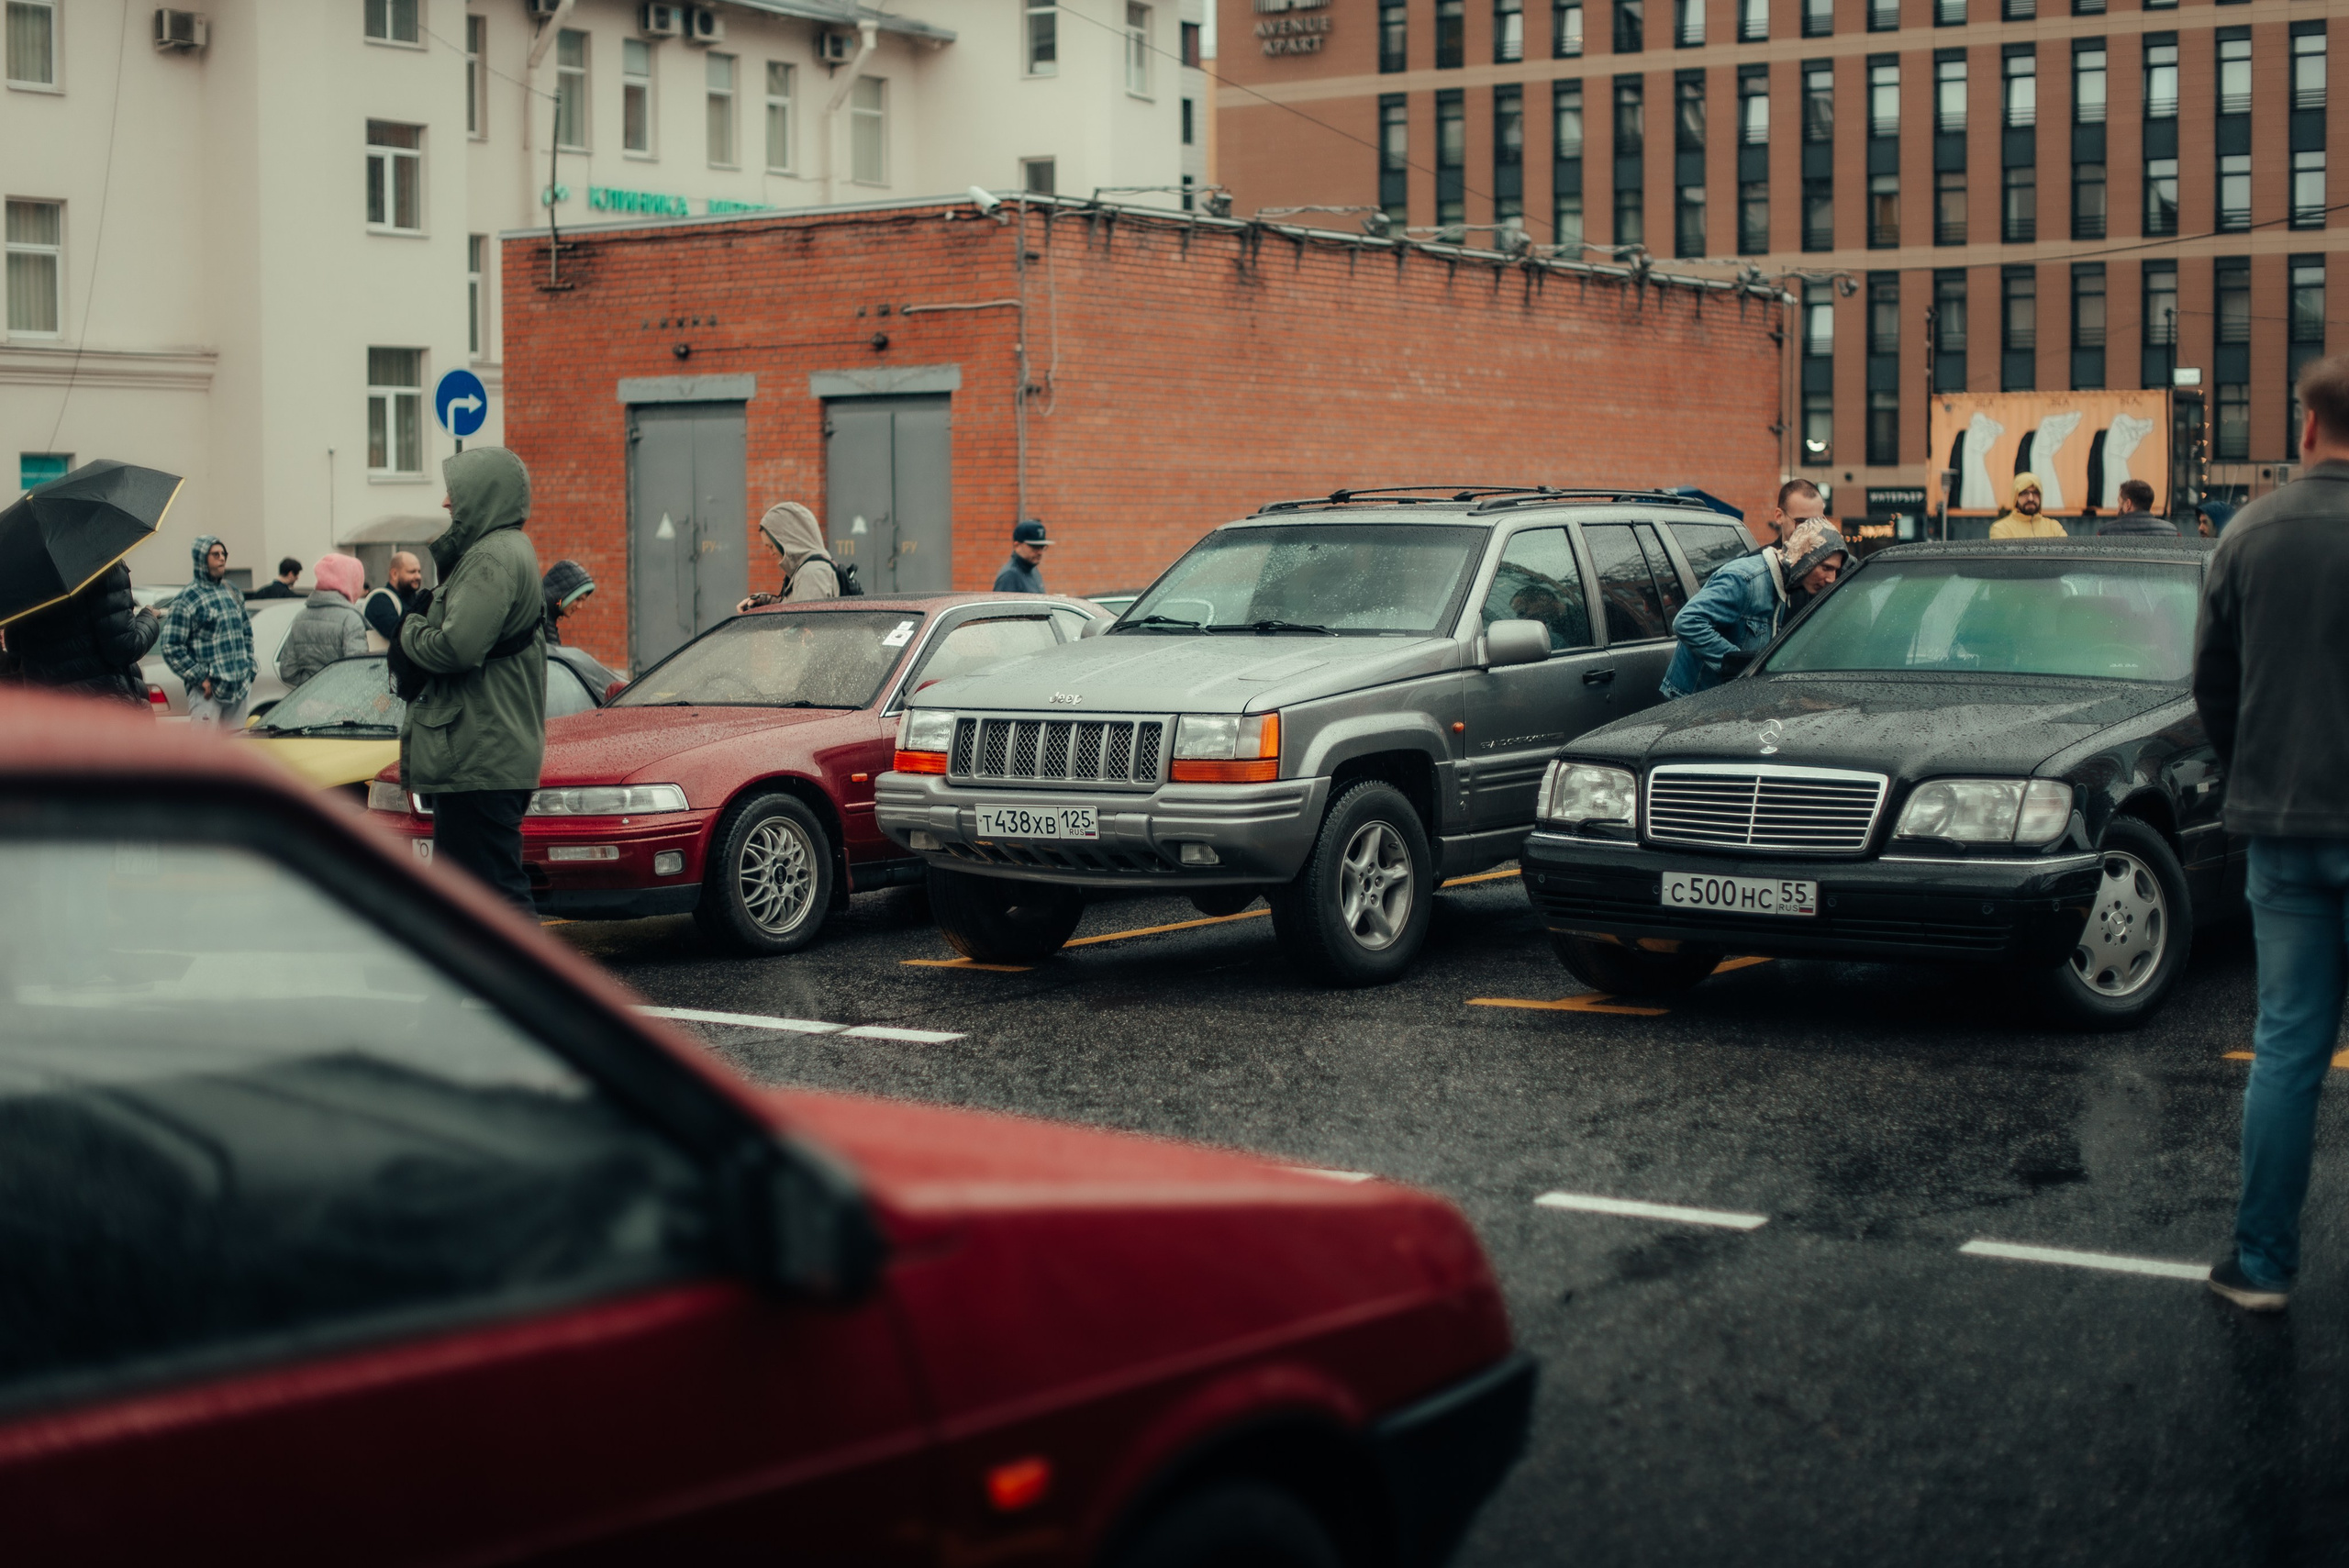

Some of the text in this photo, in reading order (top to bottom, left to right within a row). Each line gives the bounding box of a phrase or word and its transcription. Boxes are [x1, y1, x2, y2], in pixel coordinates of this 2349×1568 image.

[1252, 16, 1331, 37] AVENUE
[589, 186, 690, 217] КЛИНИКА
[835, 539, 855, 556] ТП
[1049, 691, 1083, 706] Jeep
[1061, 810, 1091, 828] 125
[1781, 882, 1807, 904] 55
[1778, 904, 1798, 912] RUS
